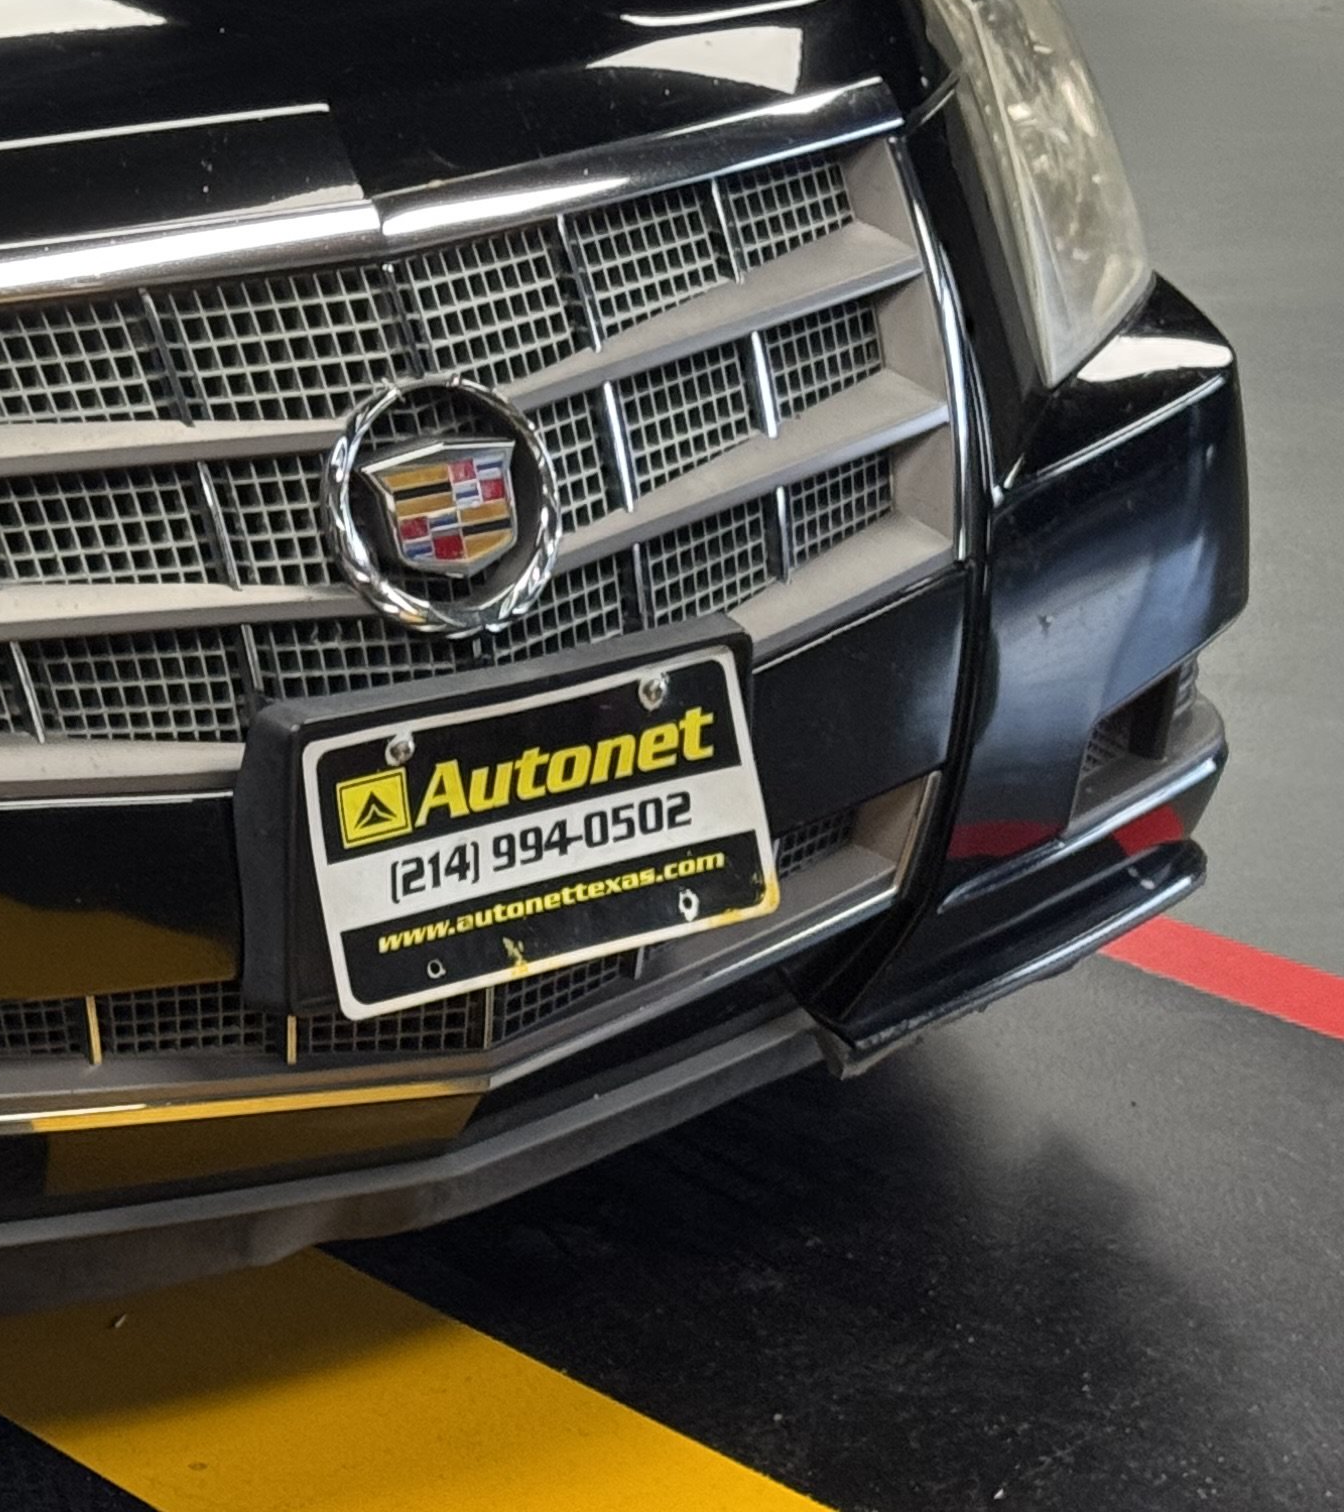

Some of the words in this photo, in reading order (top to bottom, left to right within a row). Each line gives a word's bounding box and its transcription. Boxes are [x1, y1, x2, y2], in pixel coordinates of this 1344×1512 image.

[416, 707, 714, 828] Autonet
[378, 850, 725, 954] www.autonettexas.com
[391, 843, 480, 903] (214)
[493, 791, 692, 872] 994-0502
